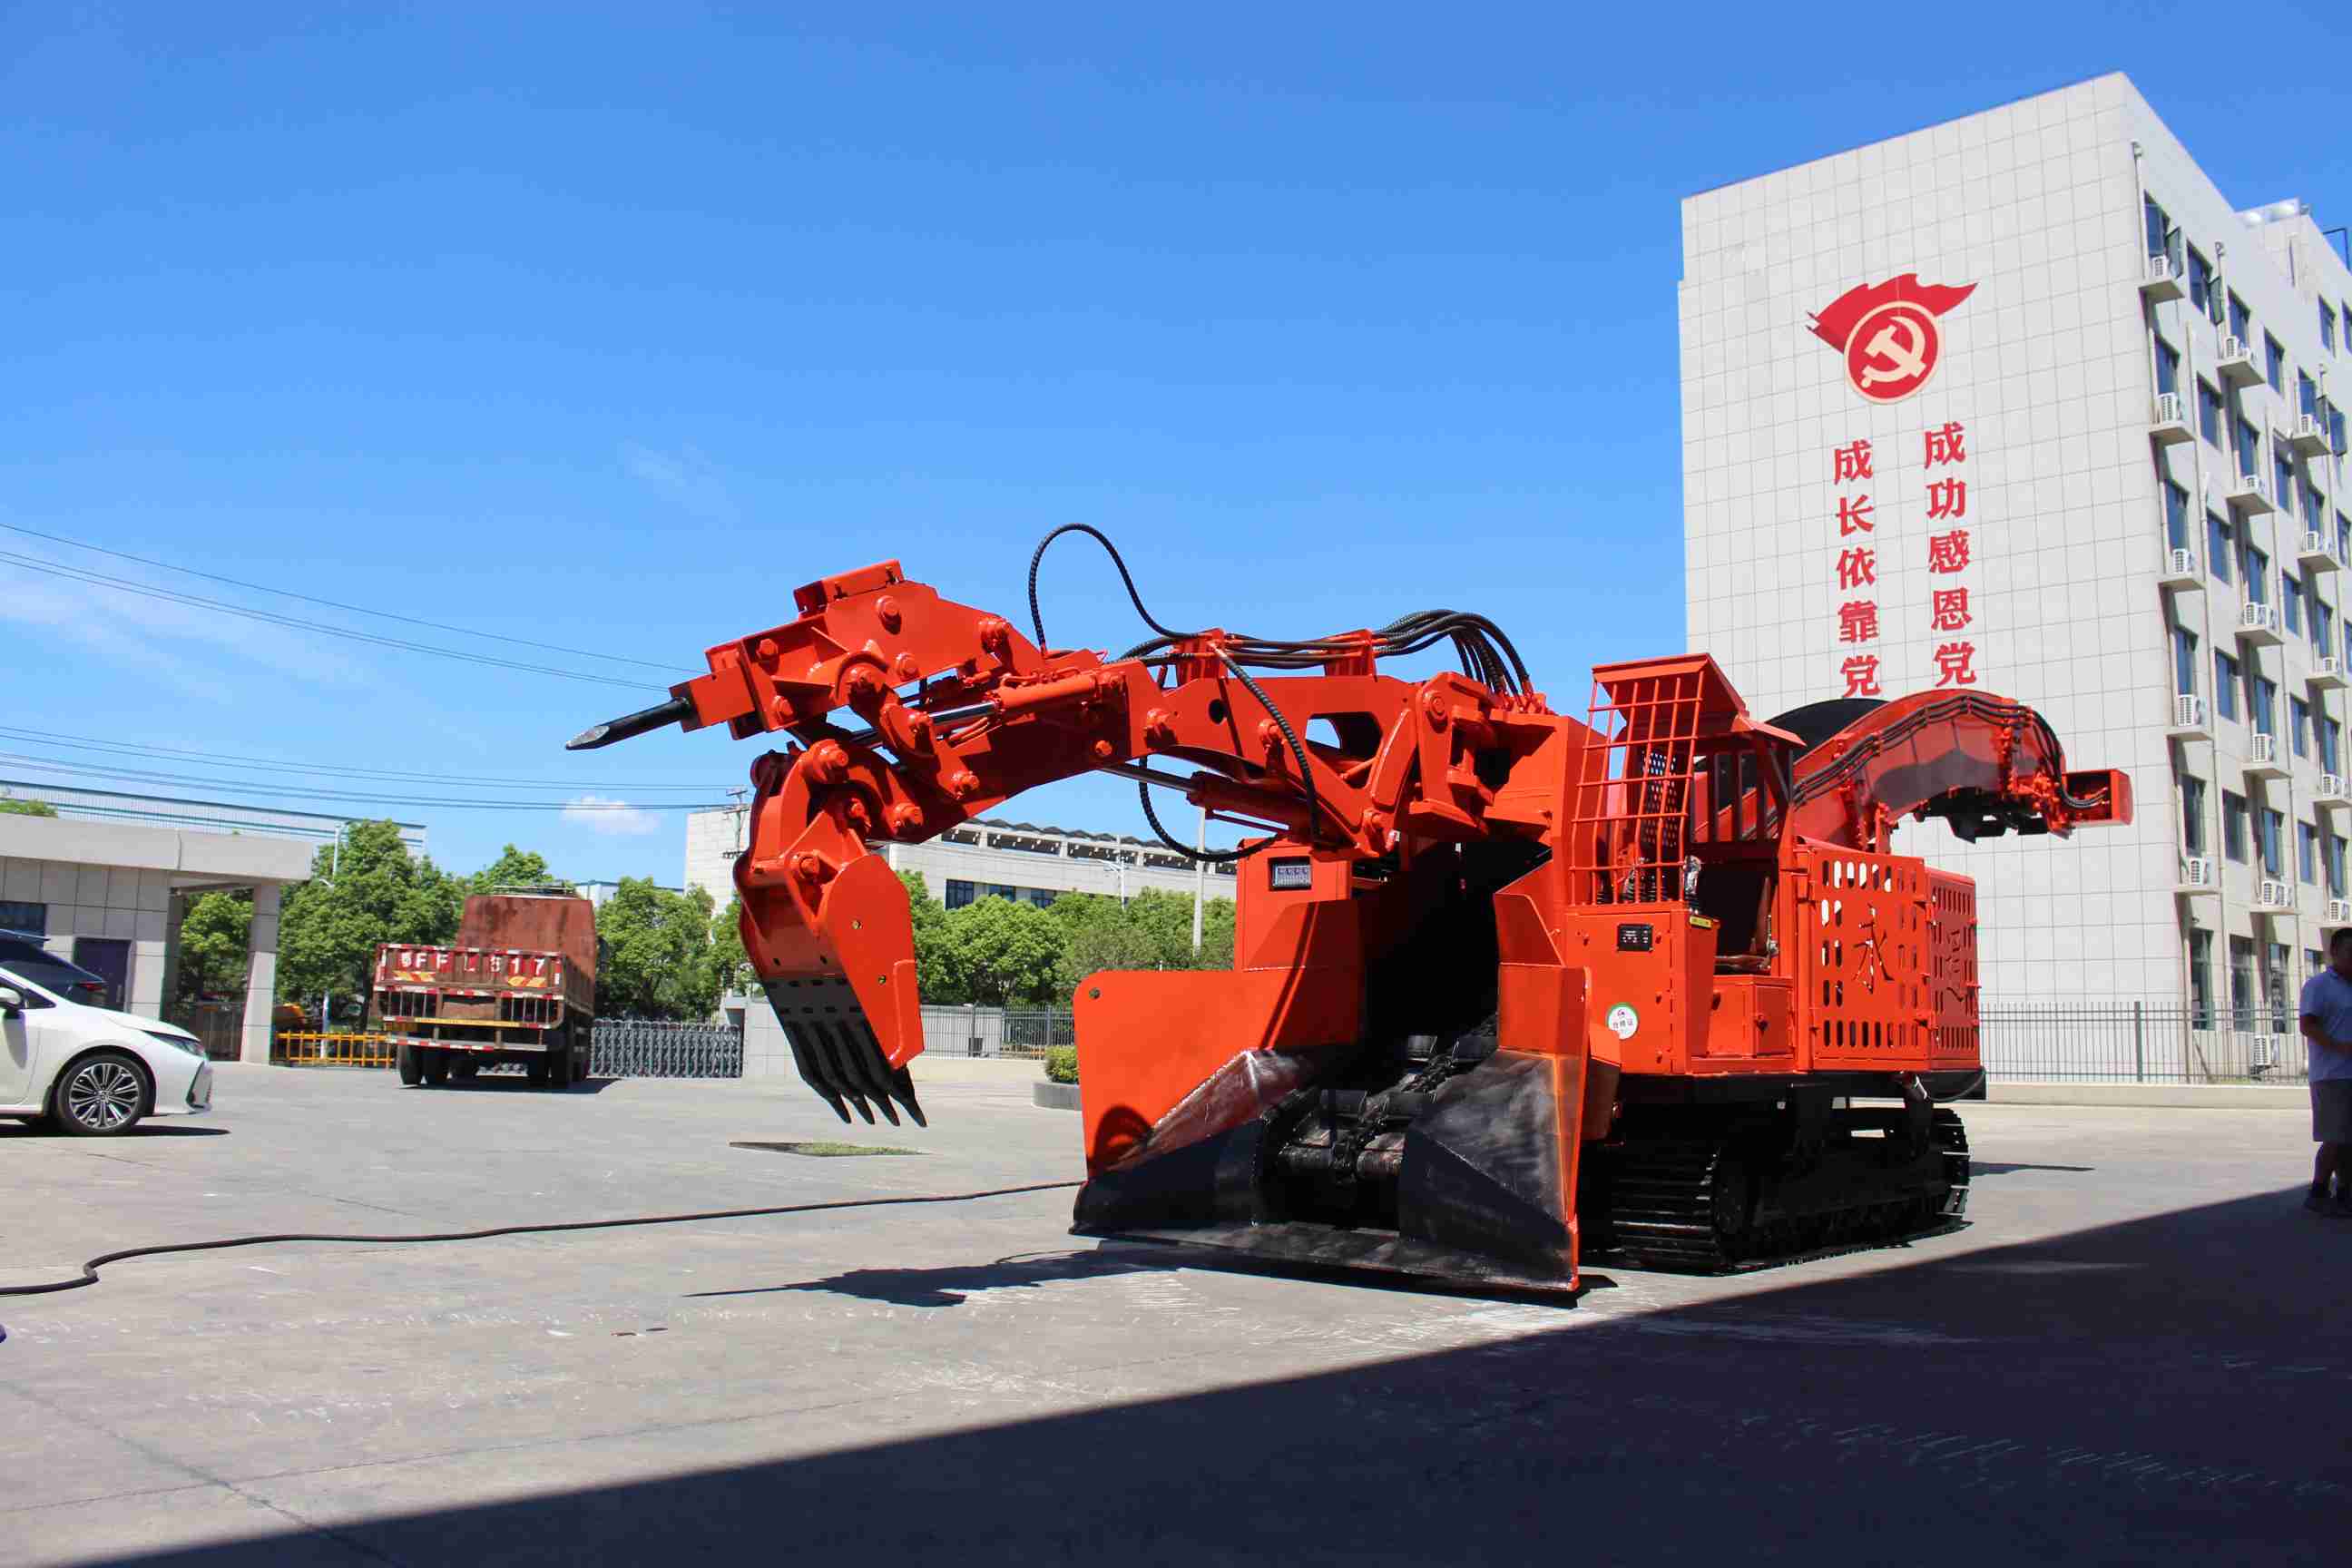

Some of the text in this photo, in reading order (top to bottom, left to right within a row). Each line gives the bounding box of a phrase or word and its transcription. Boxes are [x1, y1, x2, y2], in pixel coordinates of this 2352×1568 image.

[1834, 440, 1881, 697] 成长依靠党
[1924, 422, 1975, 687] 成功感恩党
